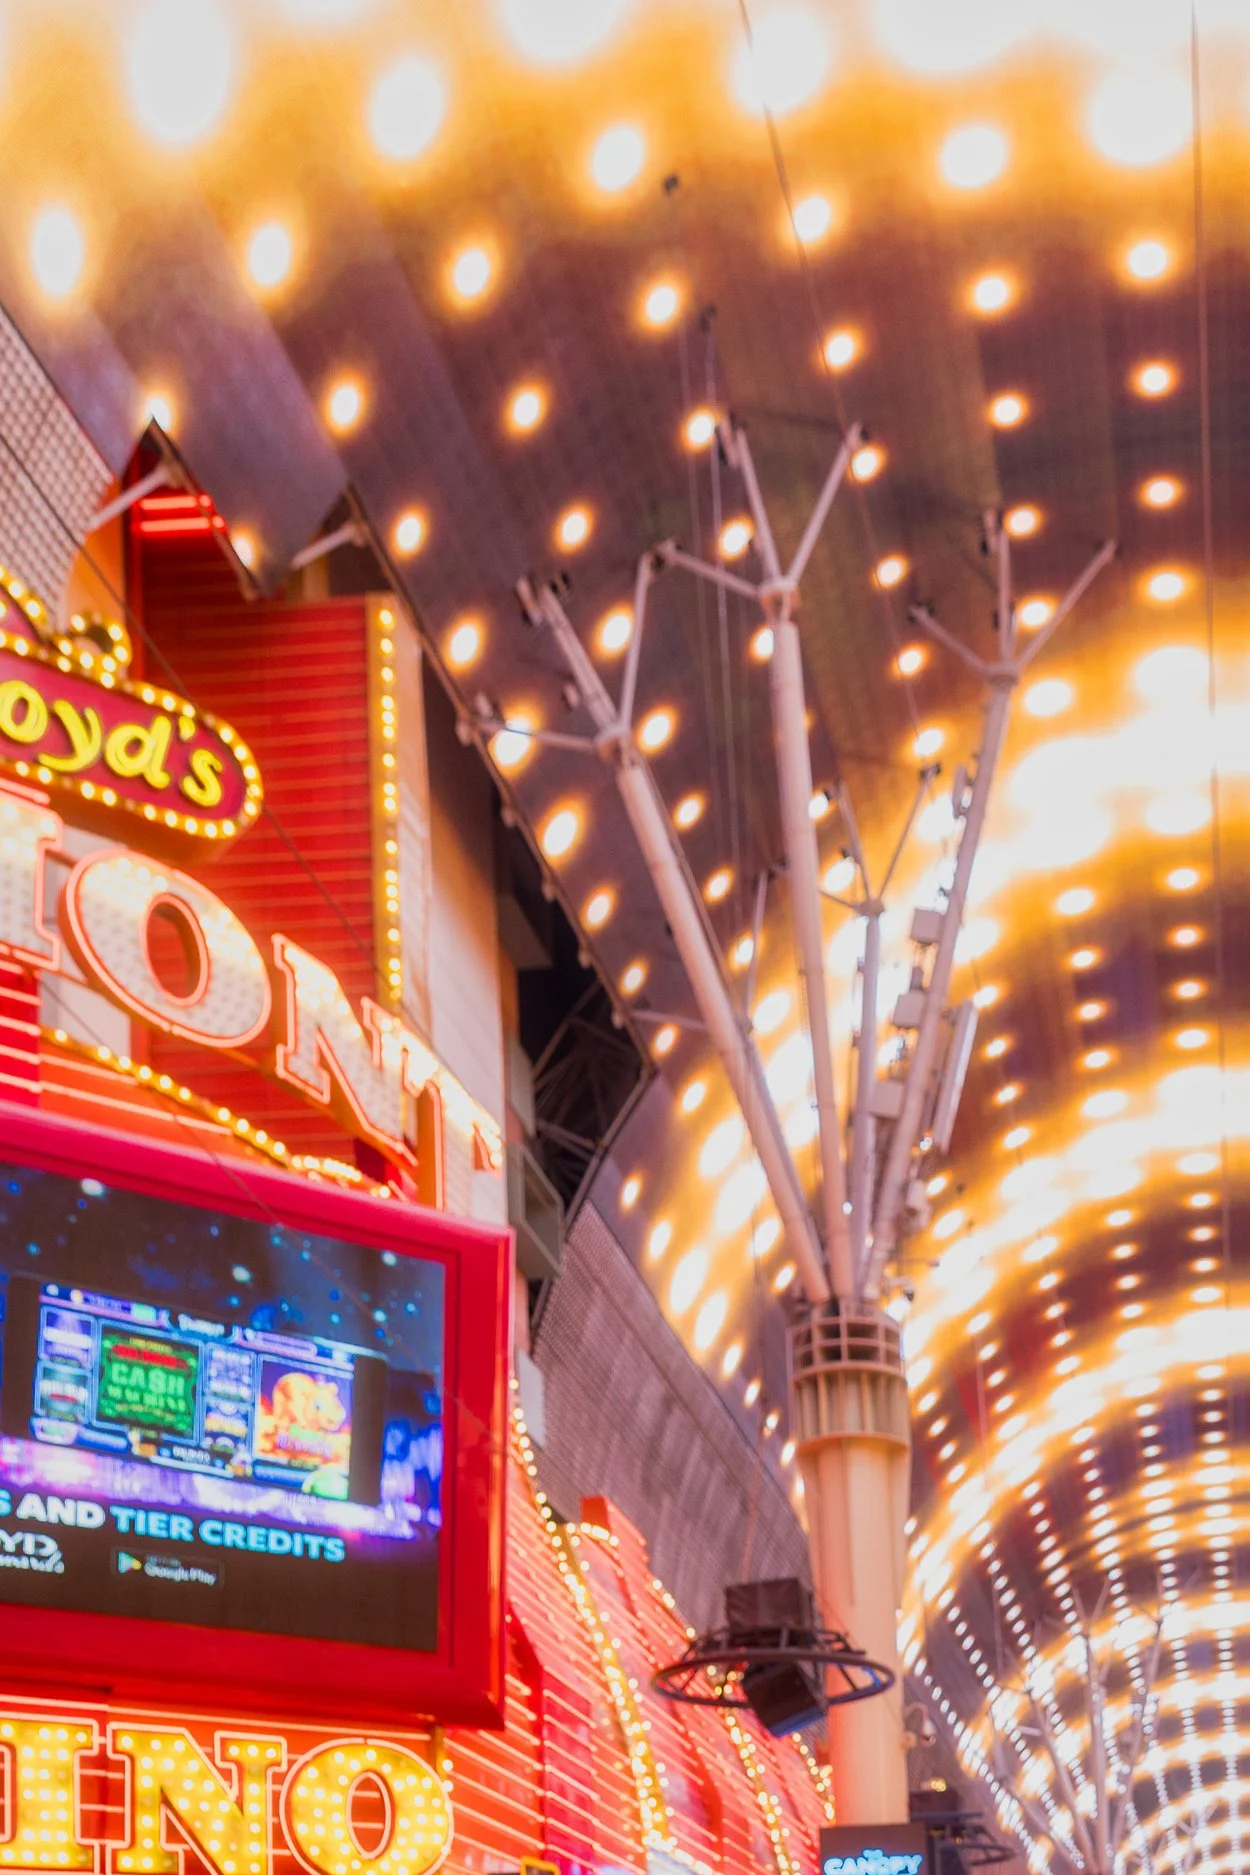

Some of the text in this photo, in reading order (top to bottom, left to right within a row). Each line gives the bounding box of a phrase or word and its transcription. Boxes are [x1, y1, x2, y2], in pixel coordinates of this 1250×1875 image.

[16, 1493, 106, 1530] AND
[109, 1505, 194, 1542] TIER
[199, 1518, 347, 1562] CREDITS
